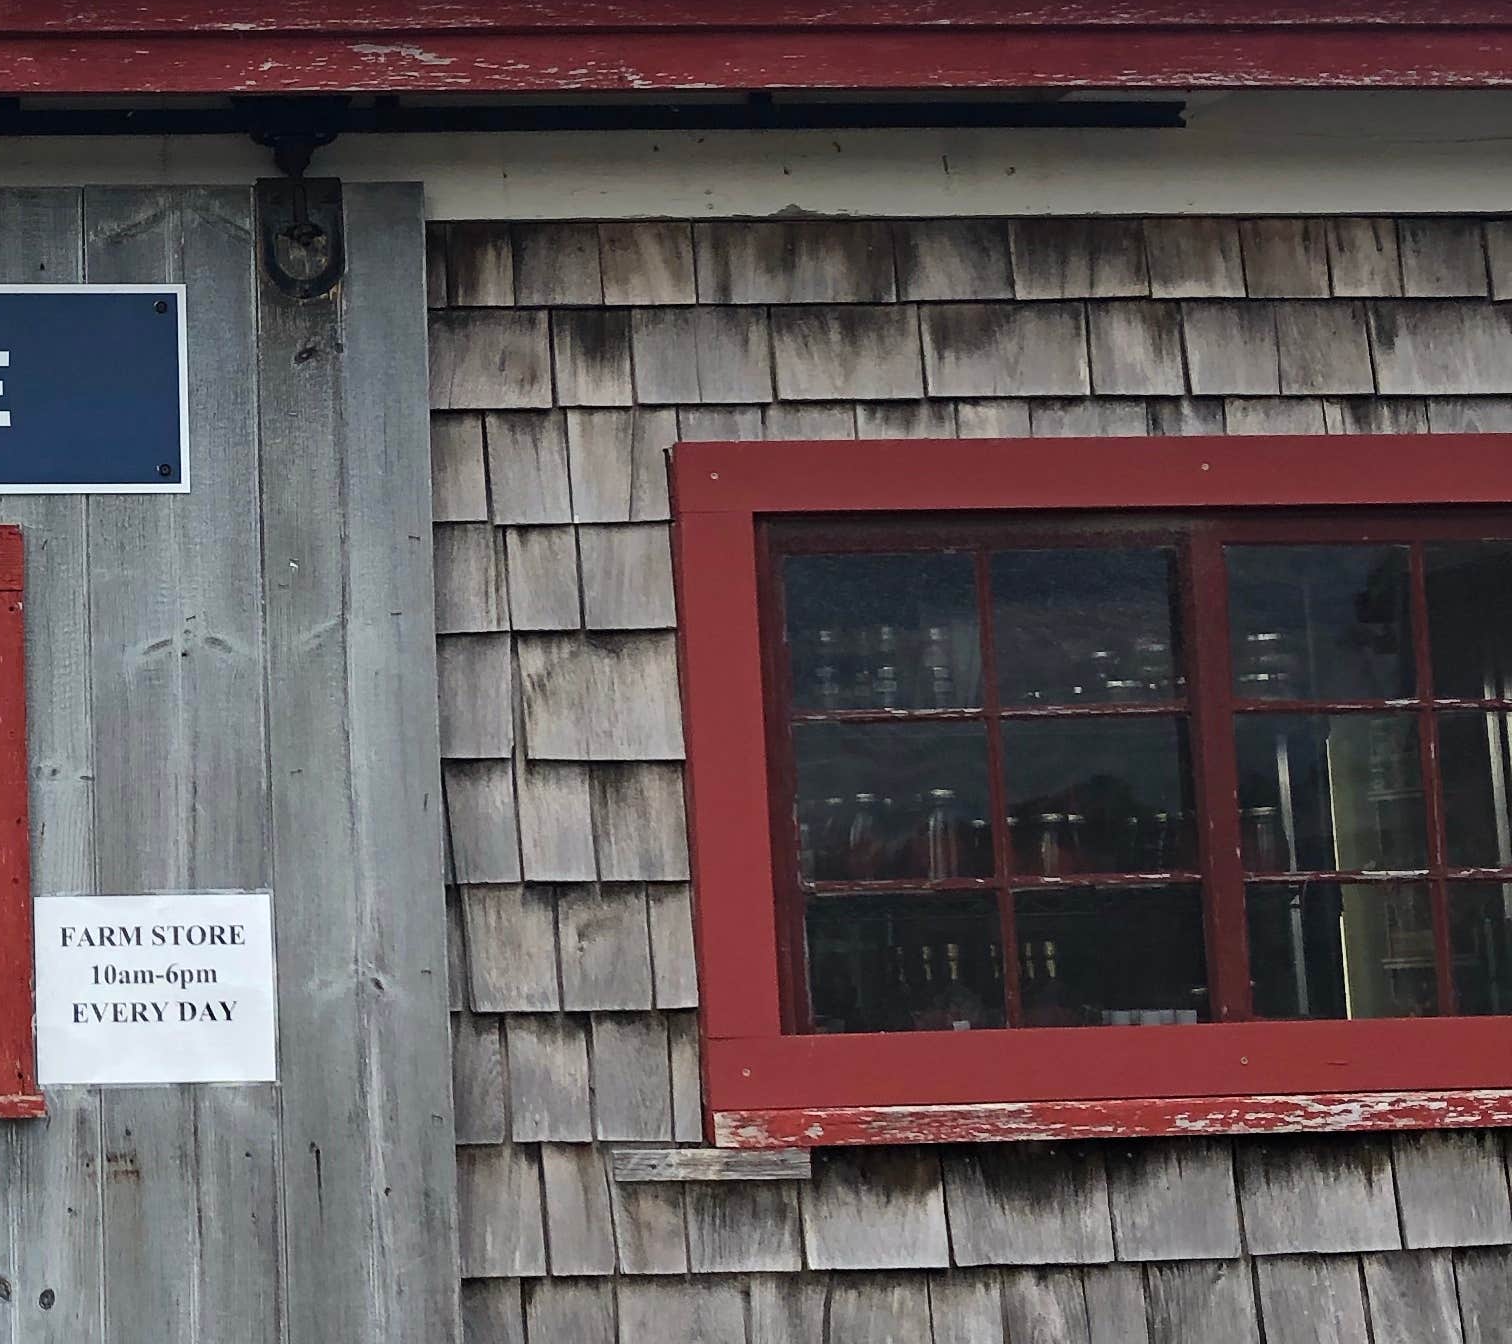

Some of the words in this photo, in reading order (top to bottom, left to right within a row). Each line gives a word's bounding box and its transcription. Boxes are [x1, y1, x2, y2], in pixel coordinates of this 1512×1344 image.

[60, 925, 143, 947] FARM
[151, 924, 246, 946] STORE
[91, 963, 218, 990] 10am-6pm
[72, 1002, 169, 1023] EVERY
[178, 1000, 237, 1022] DAY
